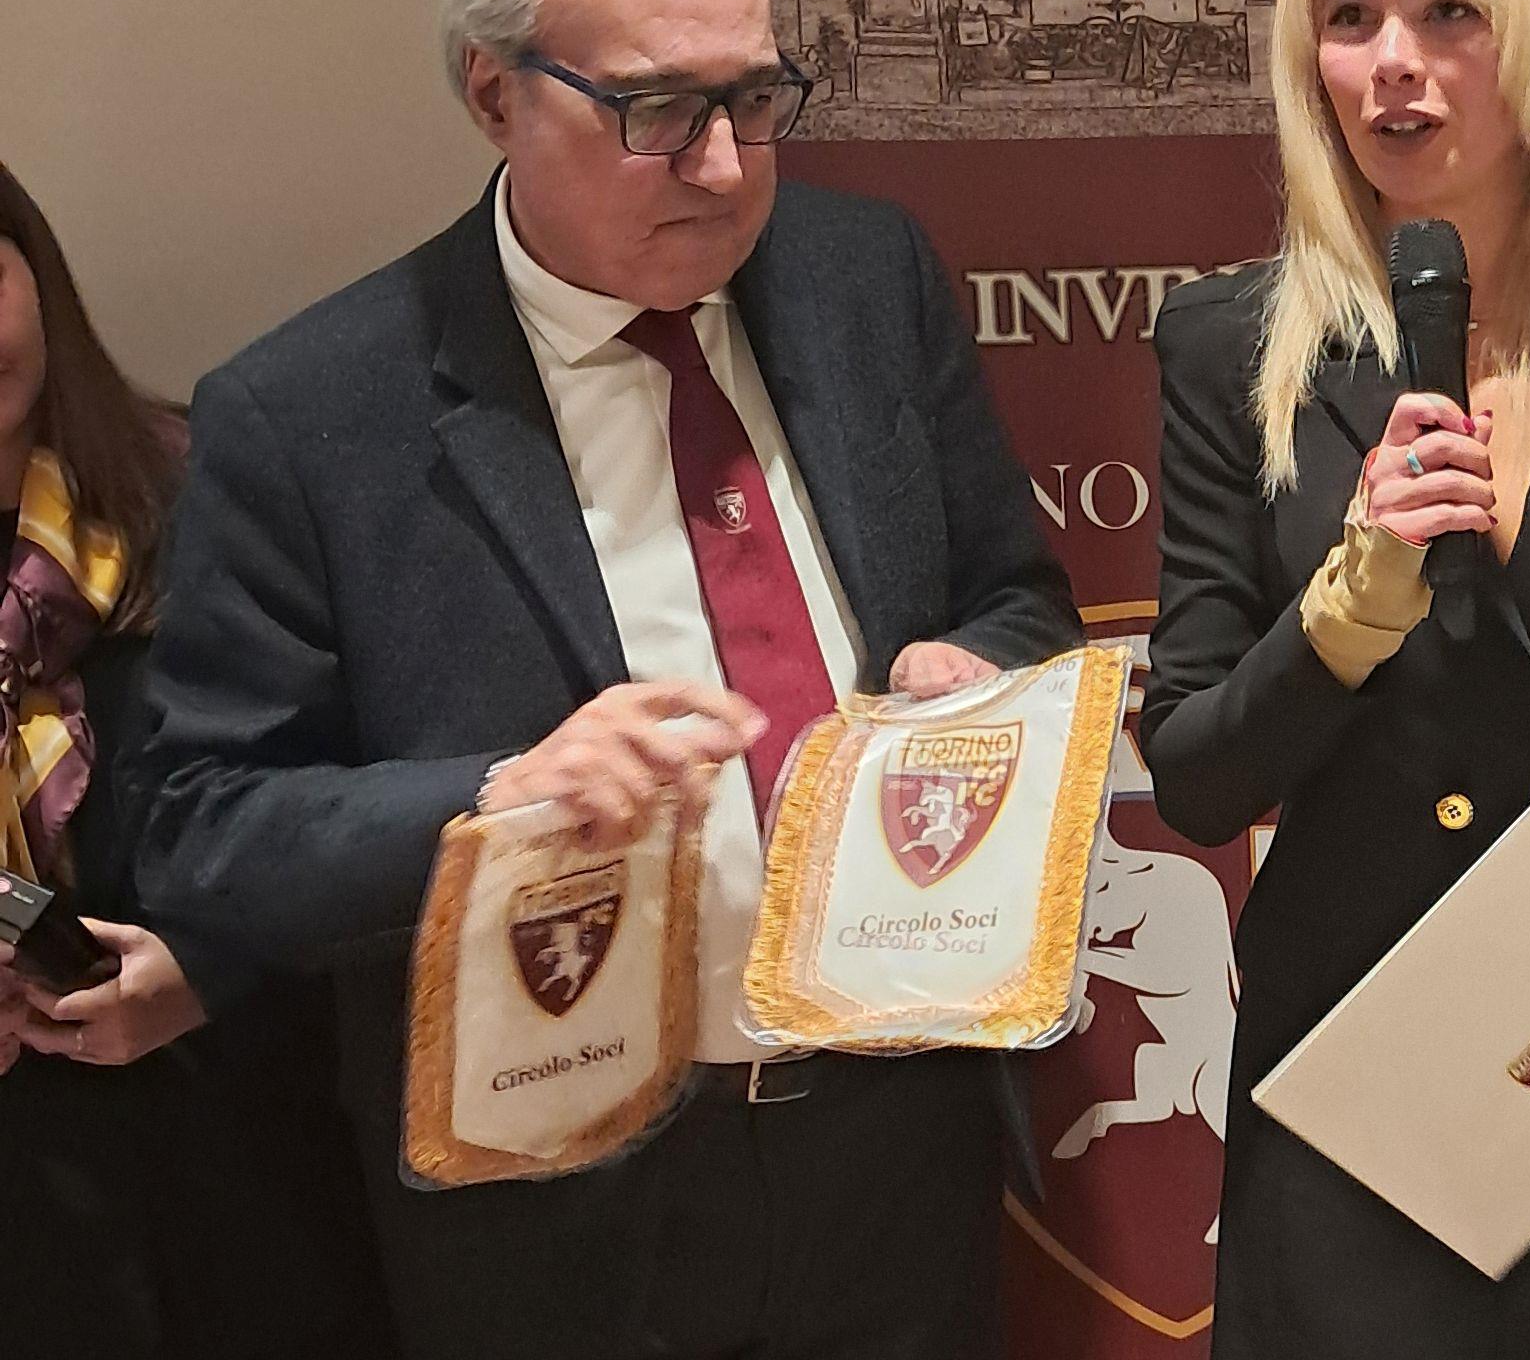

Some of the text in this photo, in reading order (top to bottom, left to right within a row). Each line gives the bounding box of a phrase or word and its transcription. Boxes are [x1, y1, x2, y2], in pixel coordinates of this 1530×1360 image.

[860, 906, 999, 935] Circolo Soci
[492, 1055, 573, 1092] Circolo
